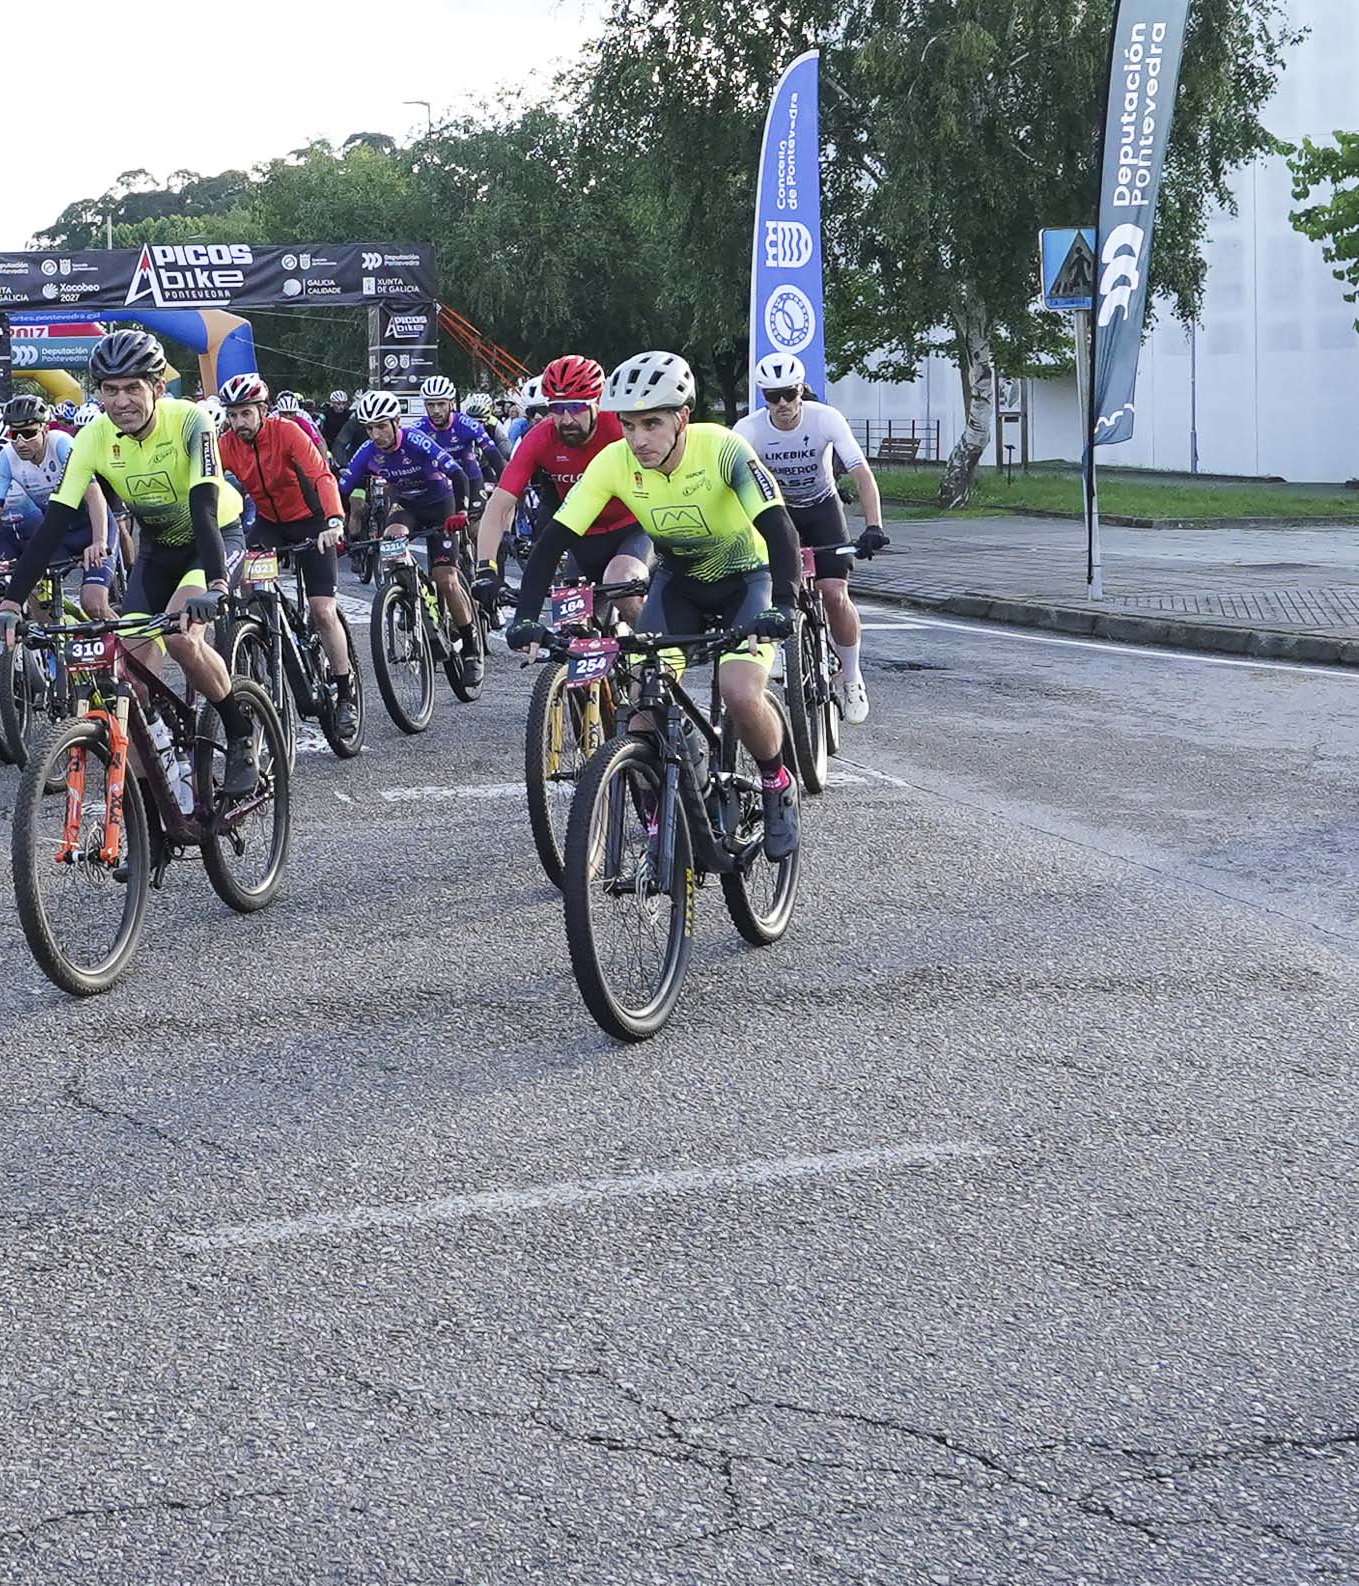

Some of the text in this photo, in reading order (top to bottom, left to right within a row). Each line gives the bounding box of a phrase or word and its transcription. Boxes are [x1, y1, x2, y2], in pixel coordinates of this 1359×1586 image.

[1113, 22, 1146, 206] Deputación
[1130, 22, 1167, 206] Pontevedra
[787, 93, 798, 210] de Pontevedra
[776, 140, 787, 210] Concello
[151, 244, 254, 266] PICOS
[159, 268, 244, 289] bike
[60, 283, 100, 292] Xacobeo
[164, 290, 231, 299] PONTEVEDRA
[60, 294, 80, 302] 2027
[42, 354, 88, 362] Pontevedra
[765, 449, 817, 461] LIKEBIKE
[72, 641, 105, 657] 310
[576, 657, 607, 674] 254
